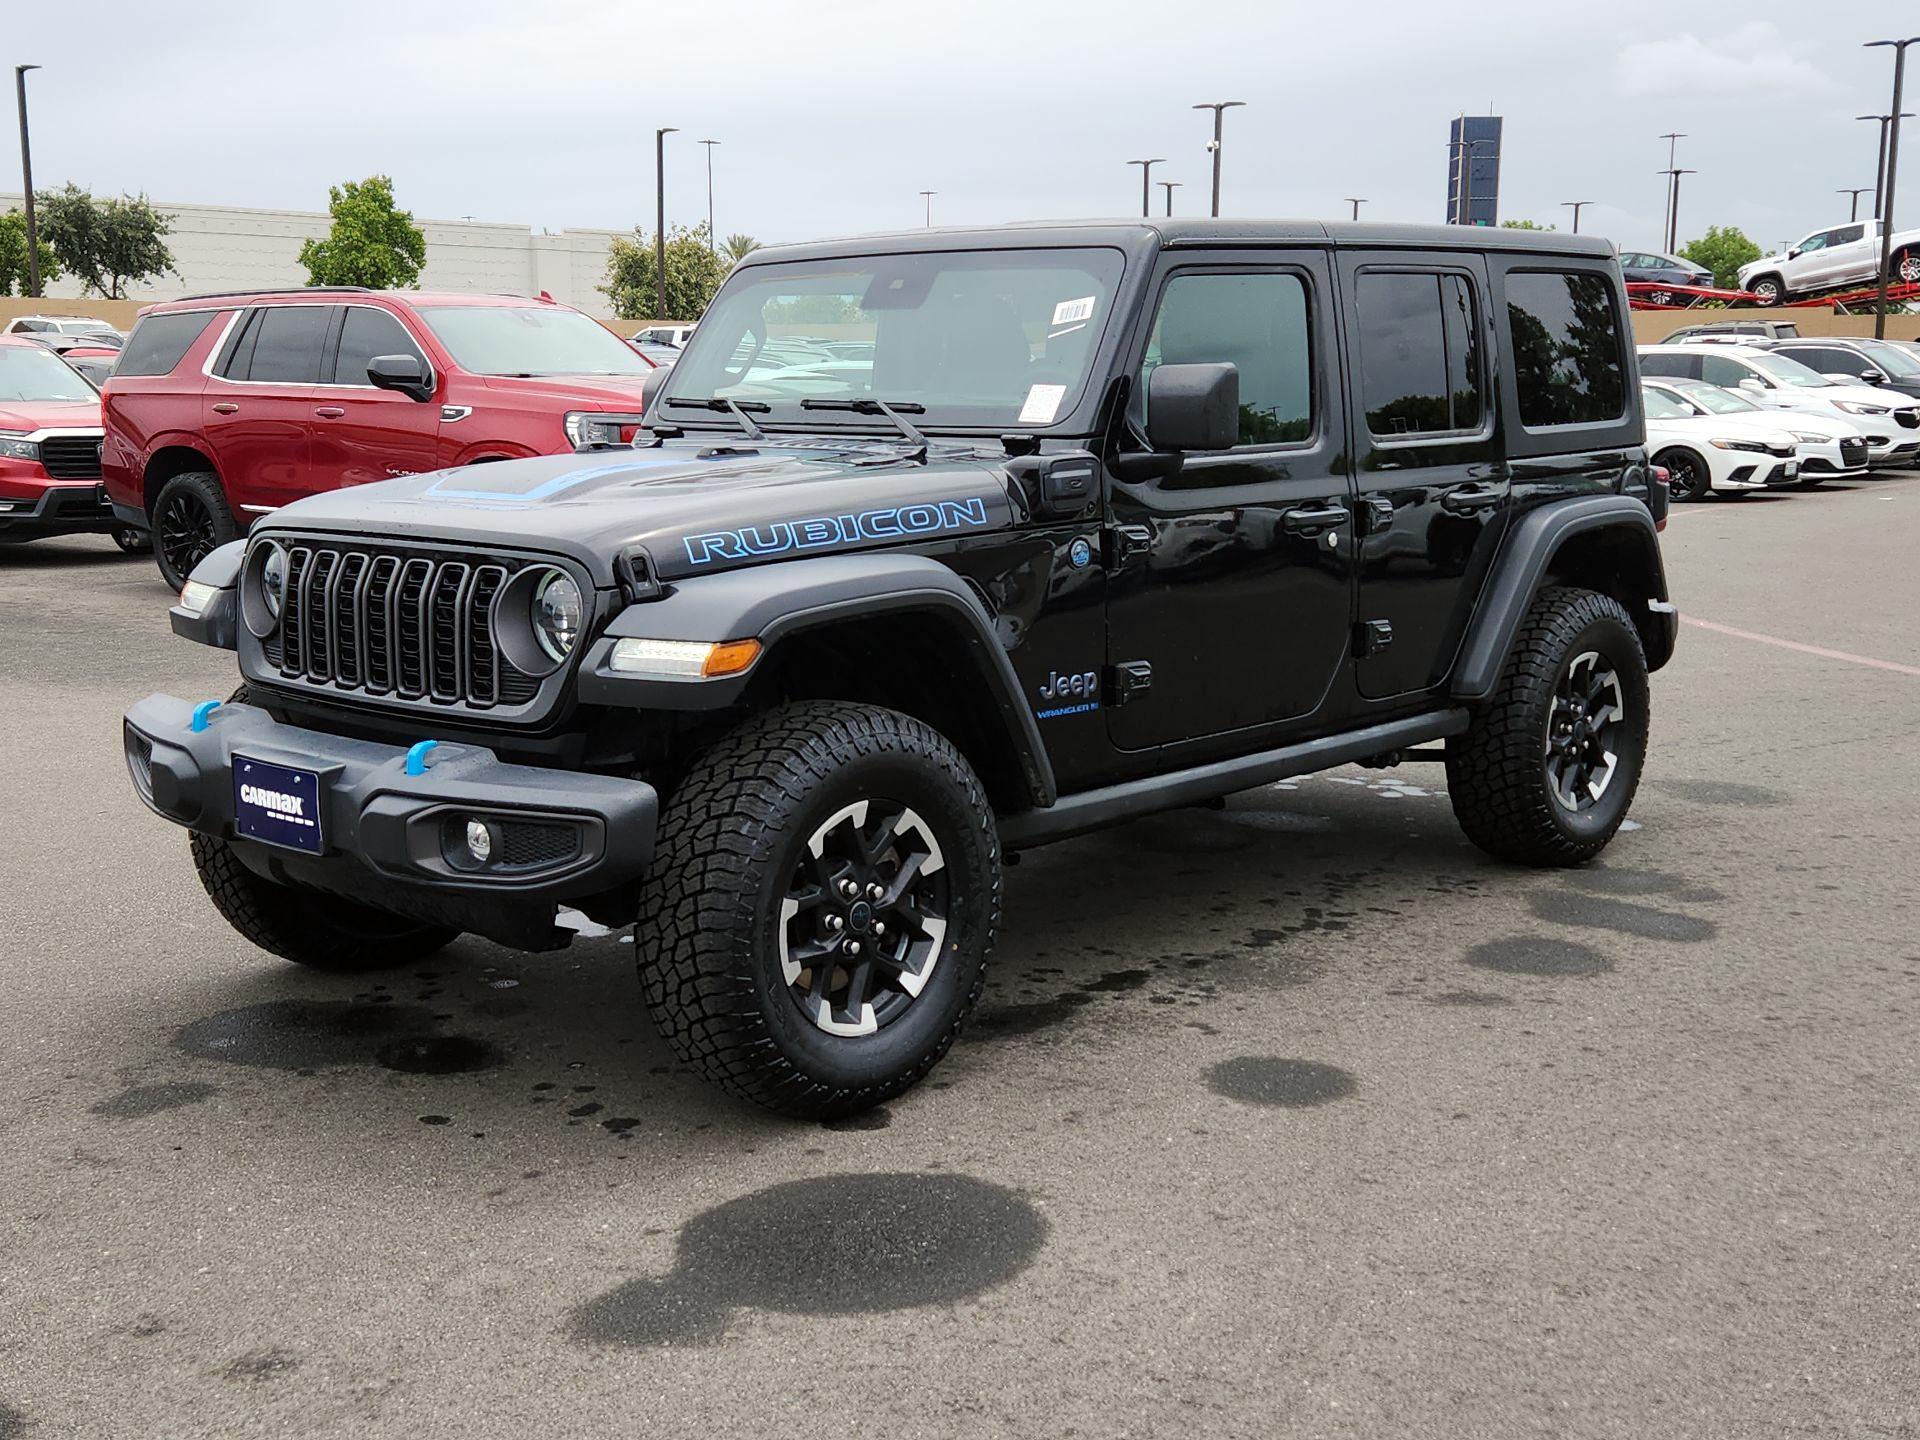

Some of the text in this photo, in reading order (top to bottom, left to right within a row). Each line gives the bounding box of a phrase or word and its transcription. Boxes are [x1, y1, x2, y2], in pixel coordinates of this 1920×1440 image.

[682, 498, 987, 565] RUBICON
[1039, 671, 1098, 700] Jeep
[1037, 703, 1089, 719] WRANGLER
